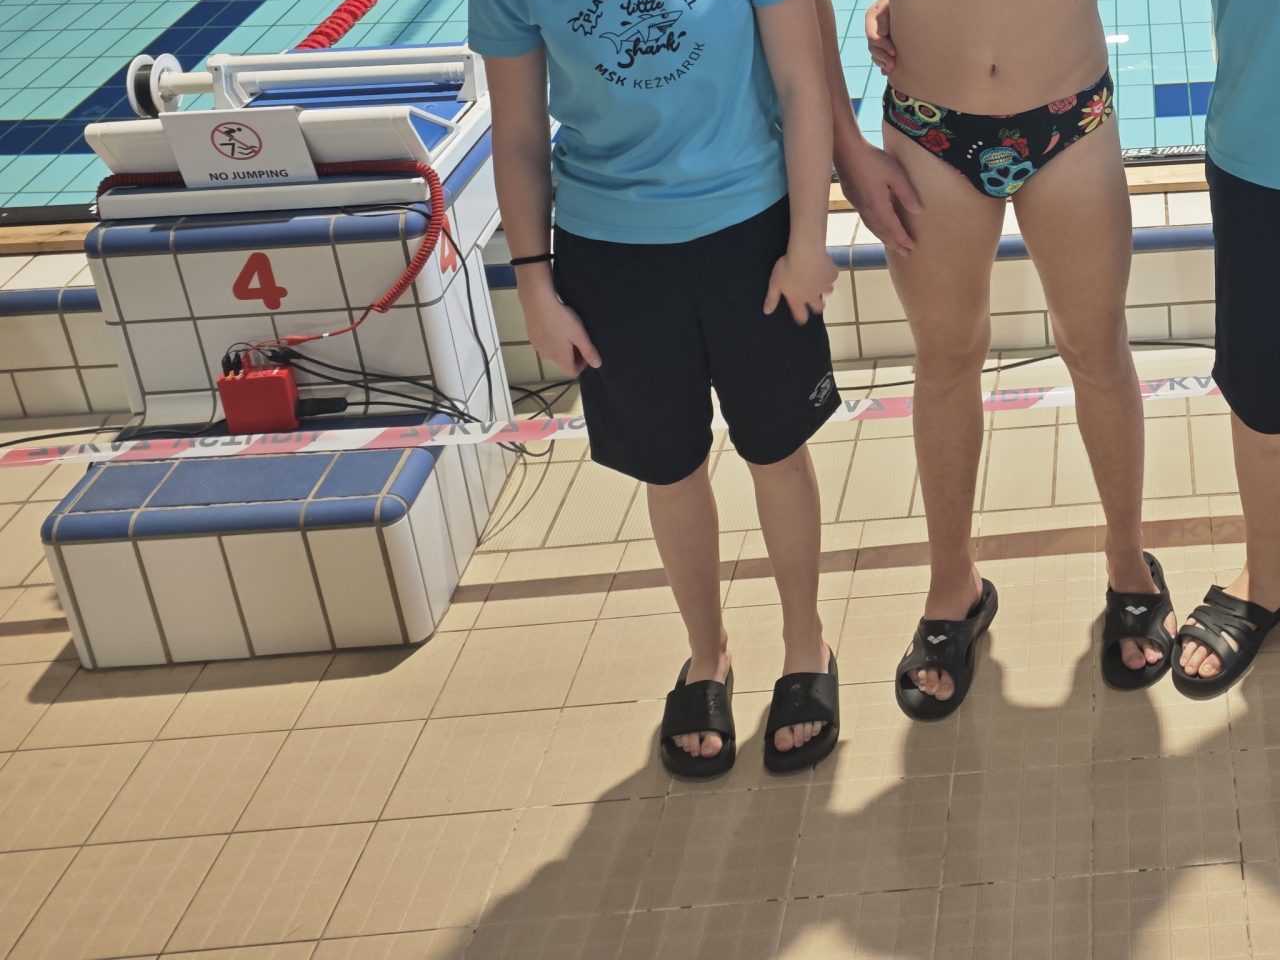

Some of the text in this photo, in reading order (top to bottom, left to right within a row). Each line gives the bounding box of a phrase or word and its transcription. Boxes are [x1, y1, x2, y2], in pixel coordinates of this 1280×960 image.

[209, 169, 289, 181] NO JUMPING
[232, 252, 288, 311] 4
